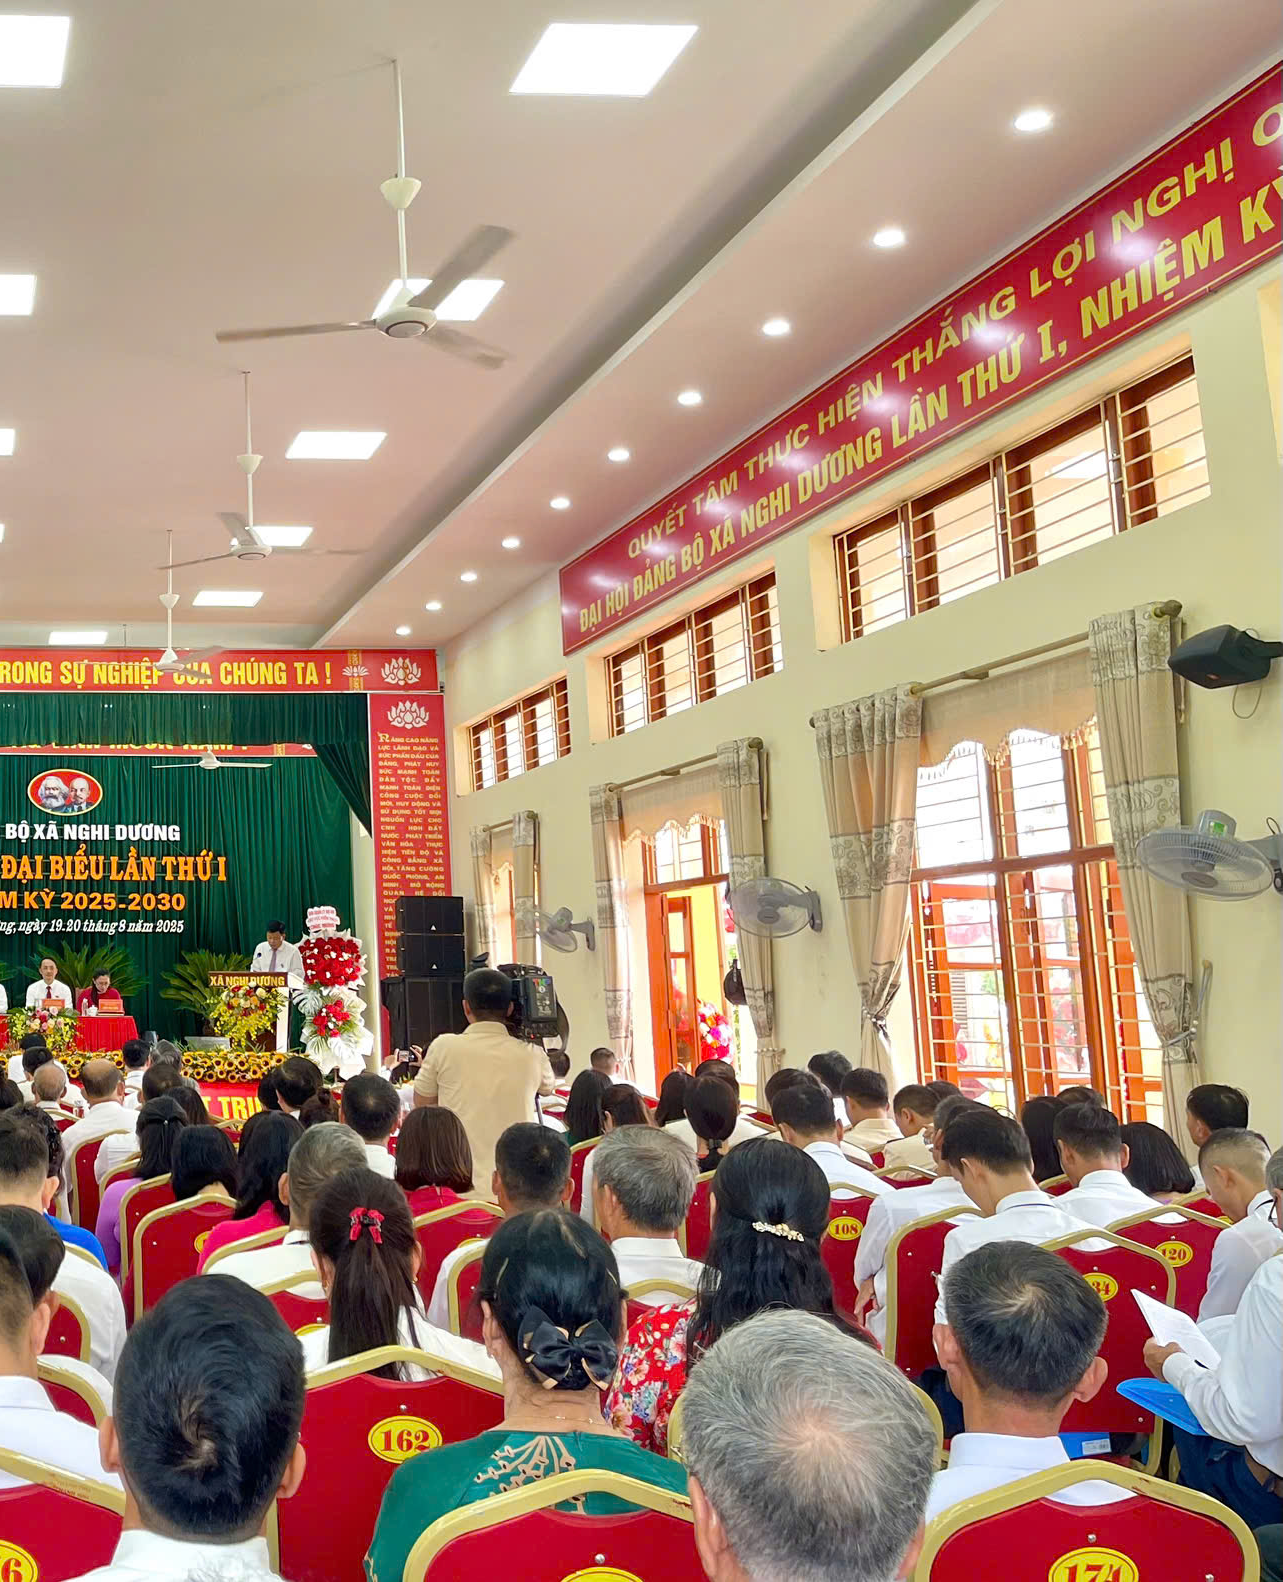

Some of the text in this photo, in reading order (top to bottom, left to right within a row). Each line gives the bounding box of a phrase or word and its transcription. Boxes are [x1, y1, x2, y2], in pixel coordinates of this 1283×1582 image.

[628, 501, 687, 559] QUYẾT
[692, 469, 739, 516] TÂM
[743, 423, 810, 481] THỰC
[818, 372, 883, 436] HIỆN
[892, 286, 1017, 384] THẮNG
[1030, 230, 1096, 298] LỢI
[1111, 137, 1234, 245] NGHỊ
[579, 598, 602, 633] ĐẠI
[605, 582, 629, 621] HỘI
[633, 557, 676, 597] ĐẢNG
[681, 532, 704, 570] BỘ
[710, 516, 735, 556] XÃ
[740, 482, 791, 538] NGHI
[797, 426, 882, 505] DƯƠNG
[891, 384, 948, 449] LẦN
[957, 332, 1025, 408] THỨ
[1080, 215, 1225, 339] NHIỆM
[60, 659, 88, 689] SỰ
[220, 657, 287, 685] CHÚNG
[293, 662, 319, 685] TA
[5, 820, 30, 844] BỘ
[33, 821, 59, 840] XÃ
[63, 824, 110, 841] NGHI
[115, 823, 181, 841] DƯƠNG
[1, 854, 43, 884] ĐẠI
[49, 844, 104, 881] BIỂU
[109, 846, 157, 882] LẦN
[162, 850, 214, 882] THỨ
[217, 856, 227, 881] I
[23, 888, 56, 910] KỲ
[60, 892, 186, 911] 2025-2030
[17, 920, 48, 934] ngày
[82, 918, 118, 935] tháng
[118, 919, 125, 932] 8
[126, 920, 153, 933] năm
[155, 920, 184, 933] 2025
[210, 975, 224, 986] XÃ
[226, 976, 248, 986] NGHI
[832, 1221, 859, 1235] 108
[380, 1427, 430, 1452] 162
